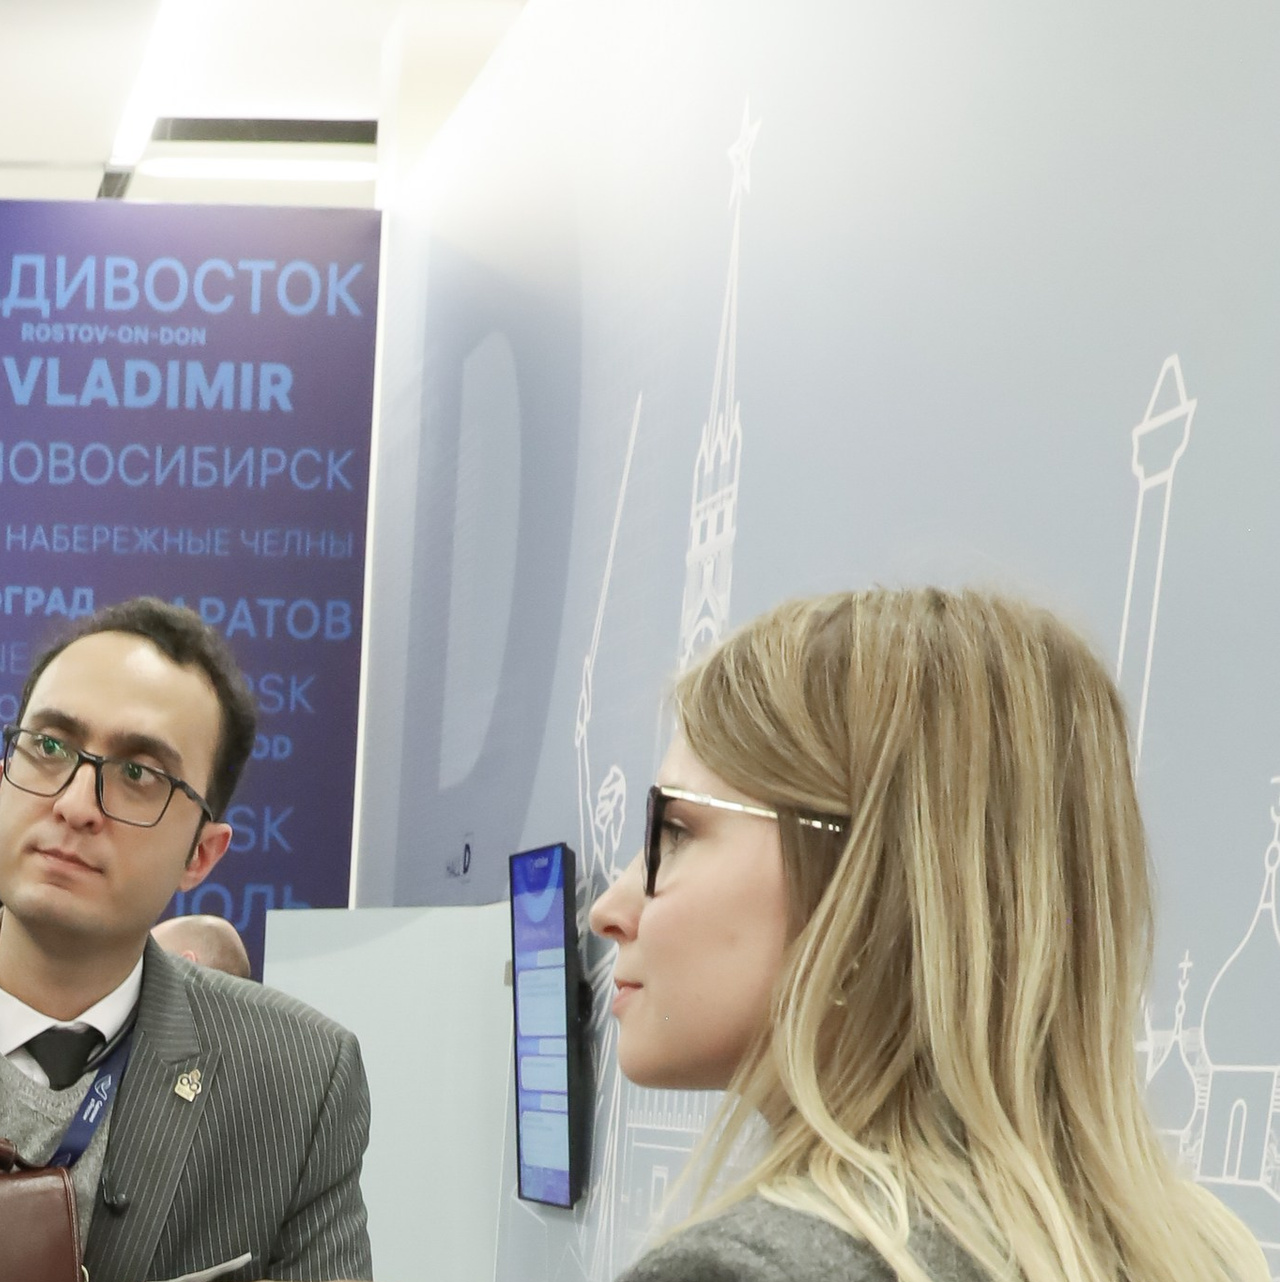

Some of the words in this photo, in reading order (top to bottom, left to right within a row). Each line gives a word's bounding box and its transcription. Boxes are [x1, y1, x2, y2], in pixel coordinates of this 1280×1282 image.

[21, 323, 206, 347] ROSTOV-ON-DON
[2, 355, 294, 413] VLADIMIR
[6, 523, 230, 557] НАБЕРЕЖНЫЕ
[240, 527, 355, 560] ЧЕЛНЫ
